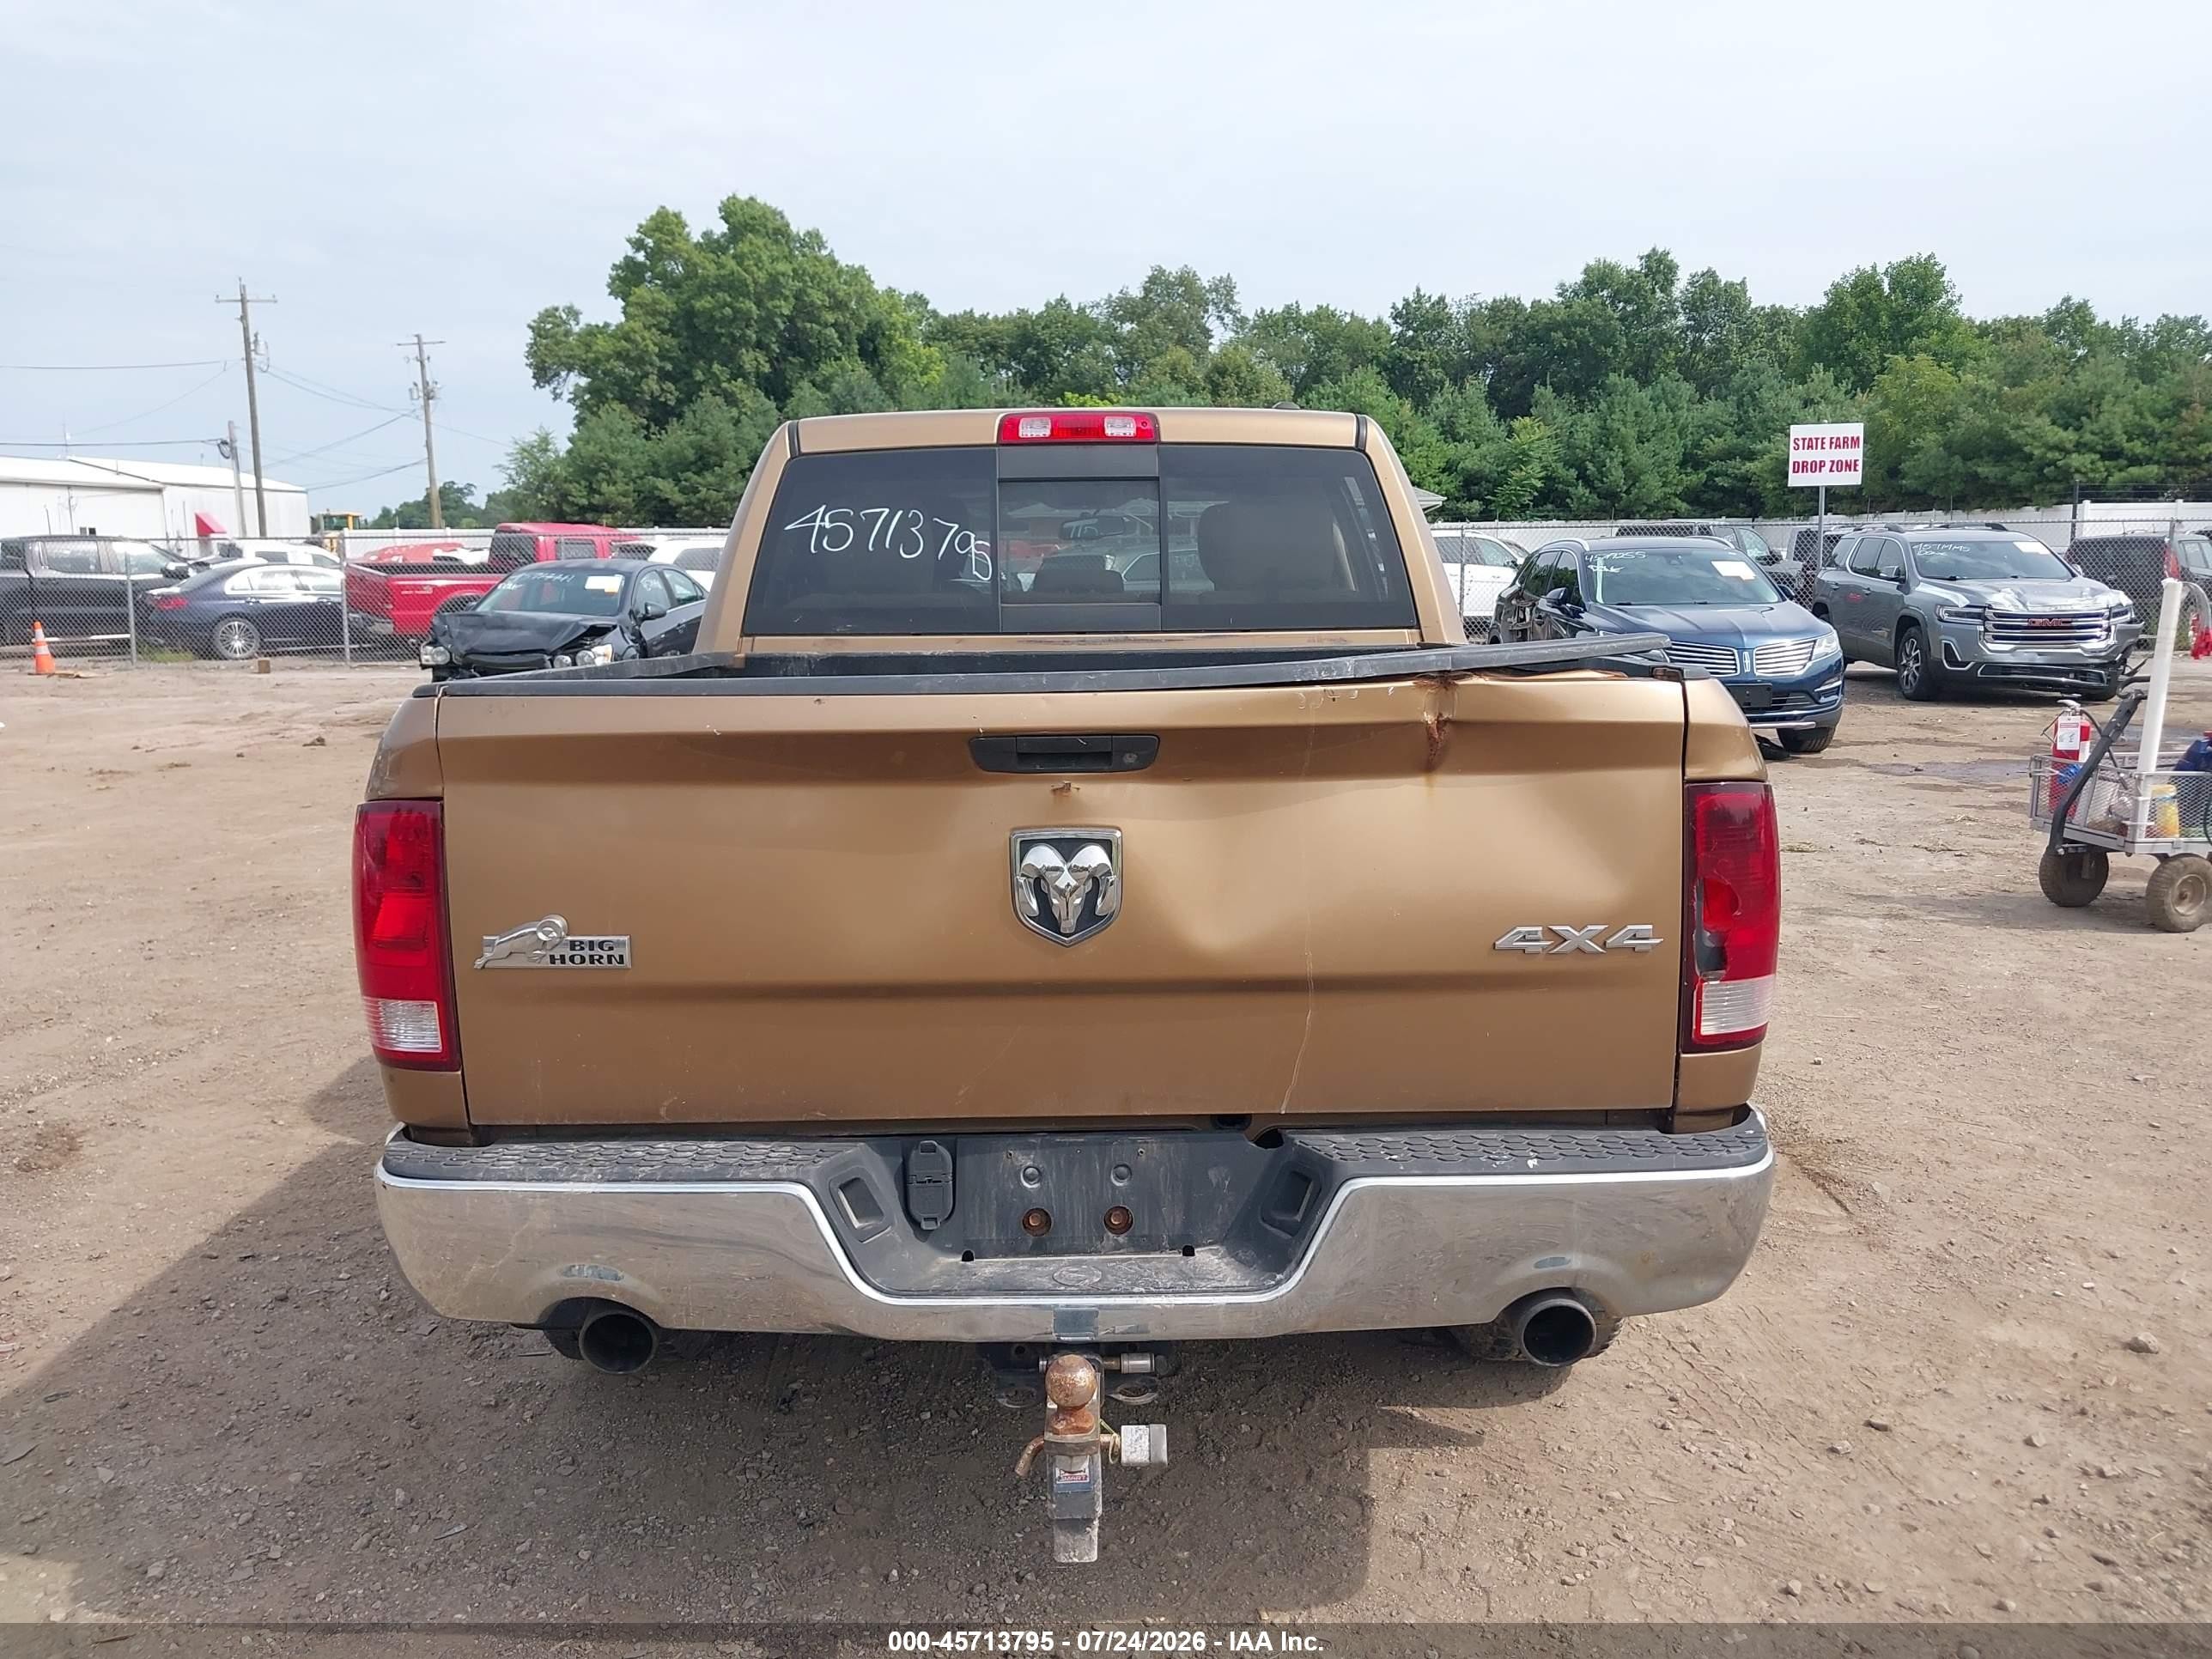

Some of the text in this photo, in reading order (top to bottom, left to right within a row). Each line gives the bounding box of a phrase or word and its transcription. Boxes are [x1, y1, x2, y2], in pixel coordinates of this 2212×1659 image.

[1793, 436, 1860, 451] STATE FARM
[1792, 459, 1860, 474] DROP ZONE
[783, 504, 993, 581] 45713795
[2027, 617, 2074, 627] GMC
[568, 940, 615, 952] BIG
[549, 954, 625, 965] HORN
